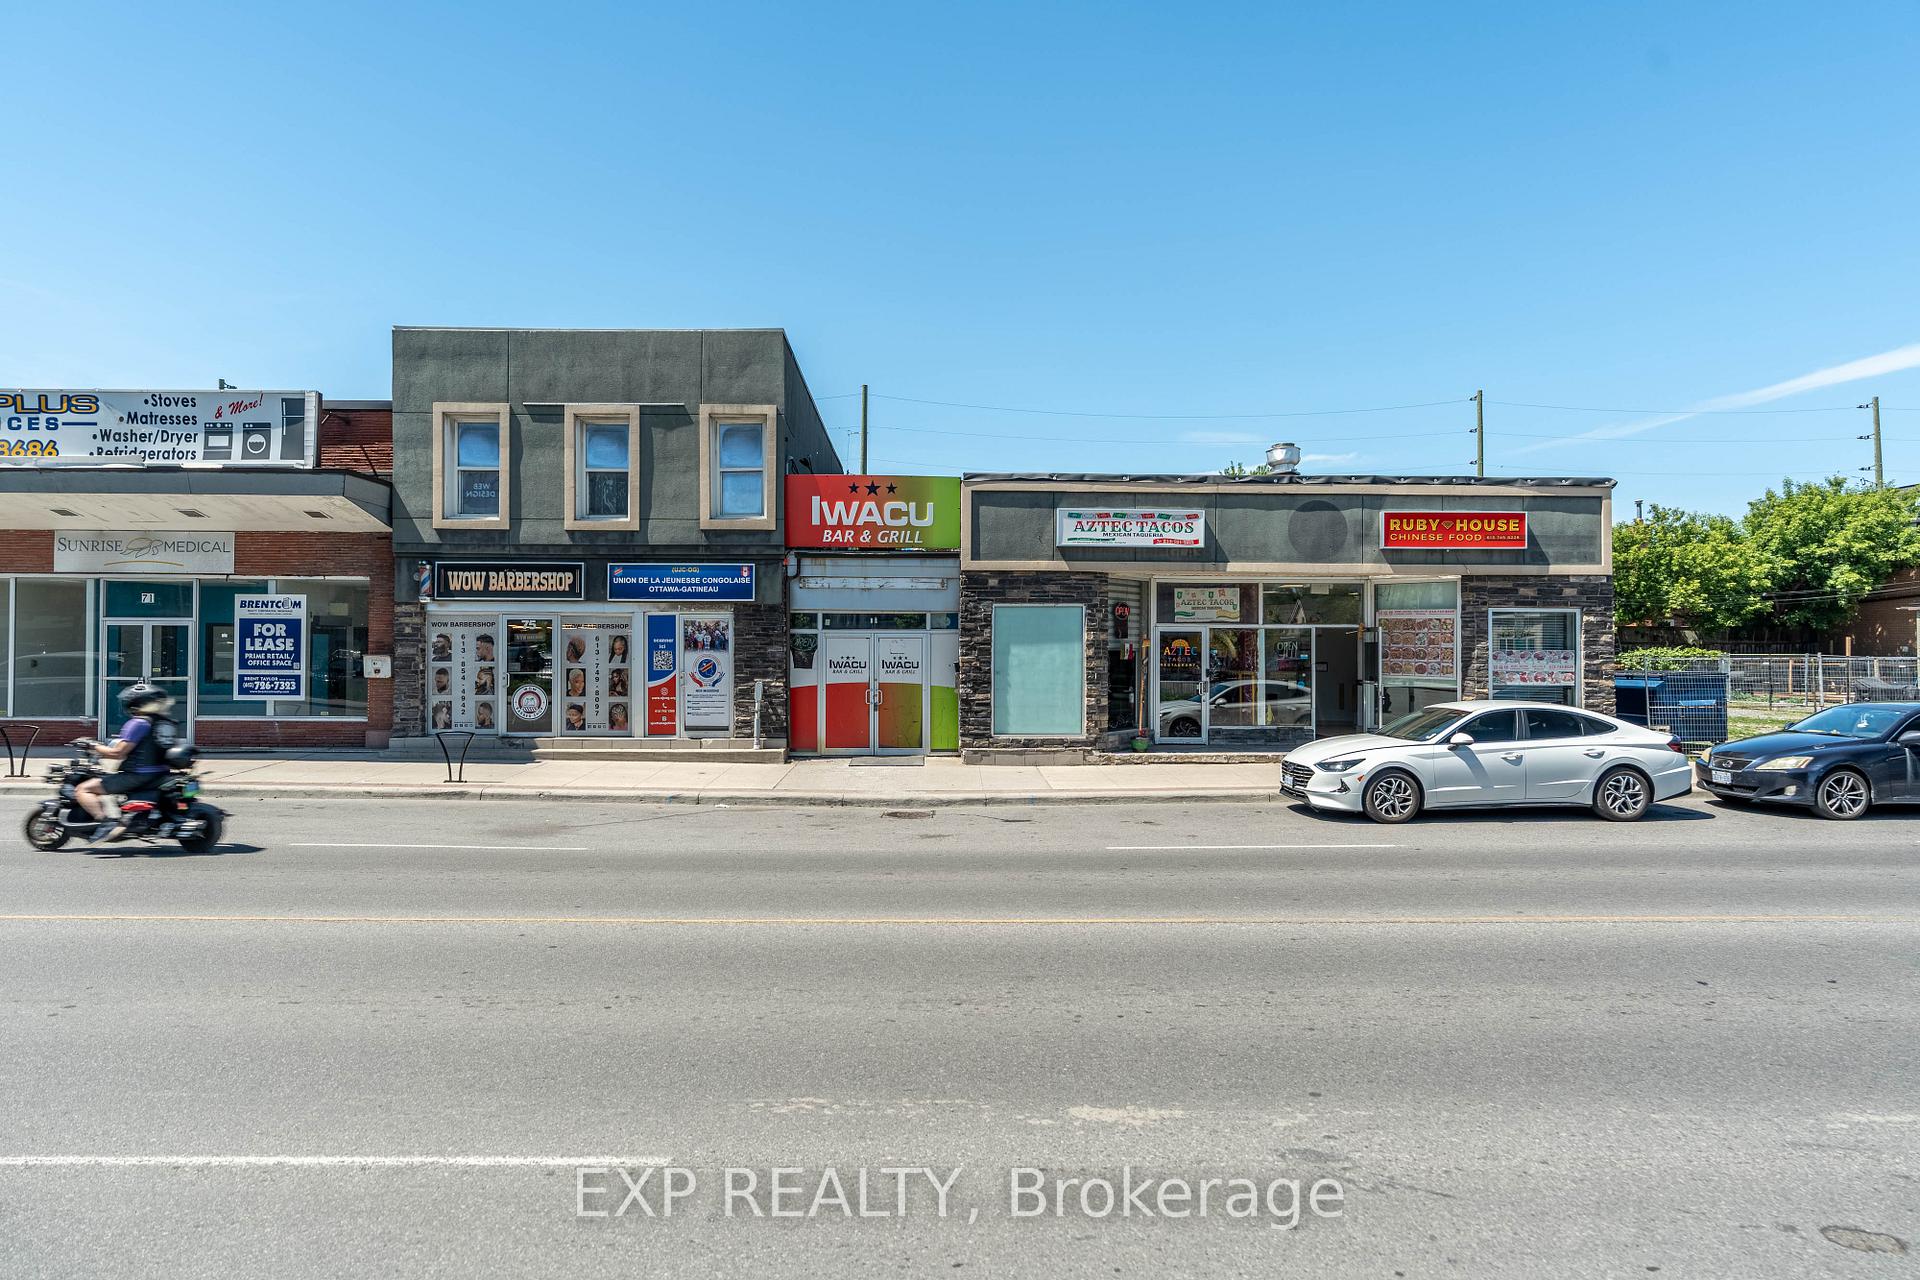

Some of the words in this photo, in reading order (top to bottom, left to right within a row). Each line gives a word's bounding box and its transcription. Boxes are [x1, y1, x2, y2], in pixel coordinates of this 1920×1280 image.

[151, 394, 196, 407] Stoves
[214, 406, 223, 419] &
[228, 391, 264, 415] More!
[0, 416, 59, 431] CES
[127, 412, 197, 425] Matresses
[100, 429, 198, 446] Washer/Dryer
[811, 495, 934, 527] IWACU
[1073, 520, 1133, 533] AZTEC
[1135, 521, 1194, 534] TACOS
[1389, 519, 1440, 531] RUBY
[1456, 519, 1520, 532] HOUSE
[822, 530, 854, 543] BAR
[859, 530, 871, 543] &
[877, 530, 923, 544] GRILL
[1390, 533, 1444, 541] CHINESE
[57, 537, 122, 552] SUNRISE
[164, 541, 231, 553] MEDICAL
[447, 571, 486, 592] WOW
[488, 571, 574, 592] BARBERSHOP
[142, 594, 154, 603] 71
[253, 623, 287, 637] FOR
[521, 619, 537, 630] 75
[245, 637, 295, 651] LEASE
[1163, 646, 1198, 656] AZTEC
[829, 659, 867, 669] IWACU
[881, 659, 920, 669] IWACU
